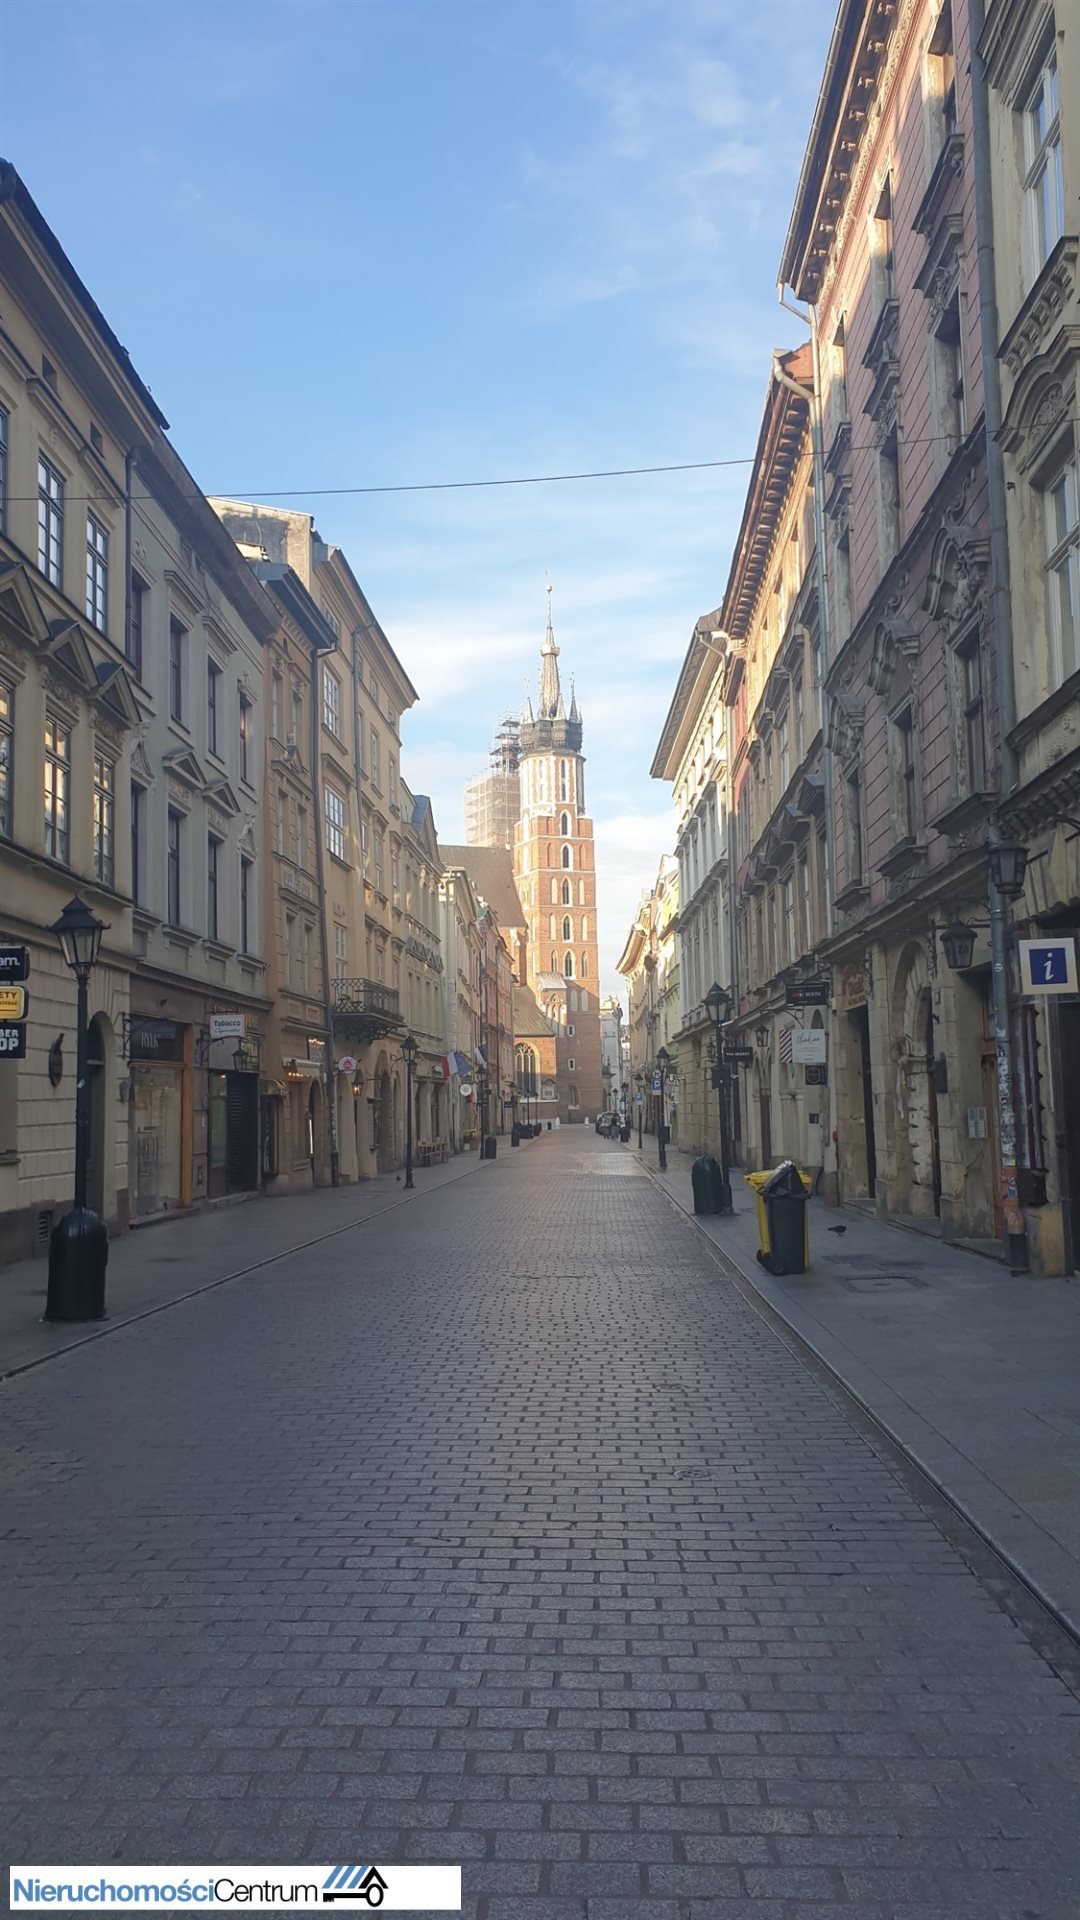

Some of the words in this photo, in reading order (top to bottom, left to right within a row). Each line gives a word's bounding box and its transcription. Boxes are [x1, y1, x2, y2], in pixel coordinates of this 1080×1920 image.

[1043, 952, 1054, 981] i
[214, 1020, 241, 1028] Tobacco
[654, 1080, 660, 1089] P
